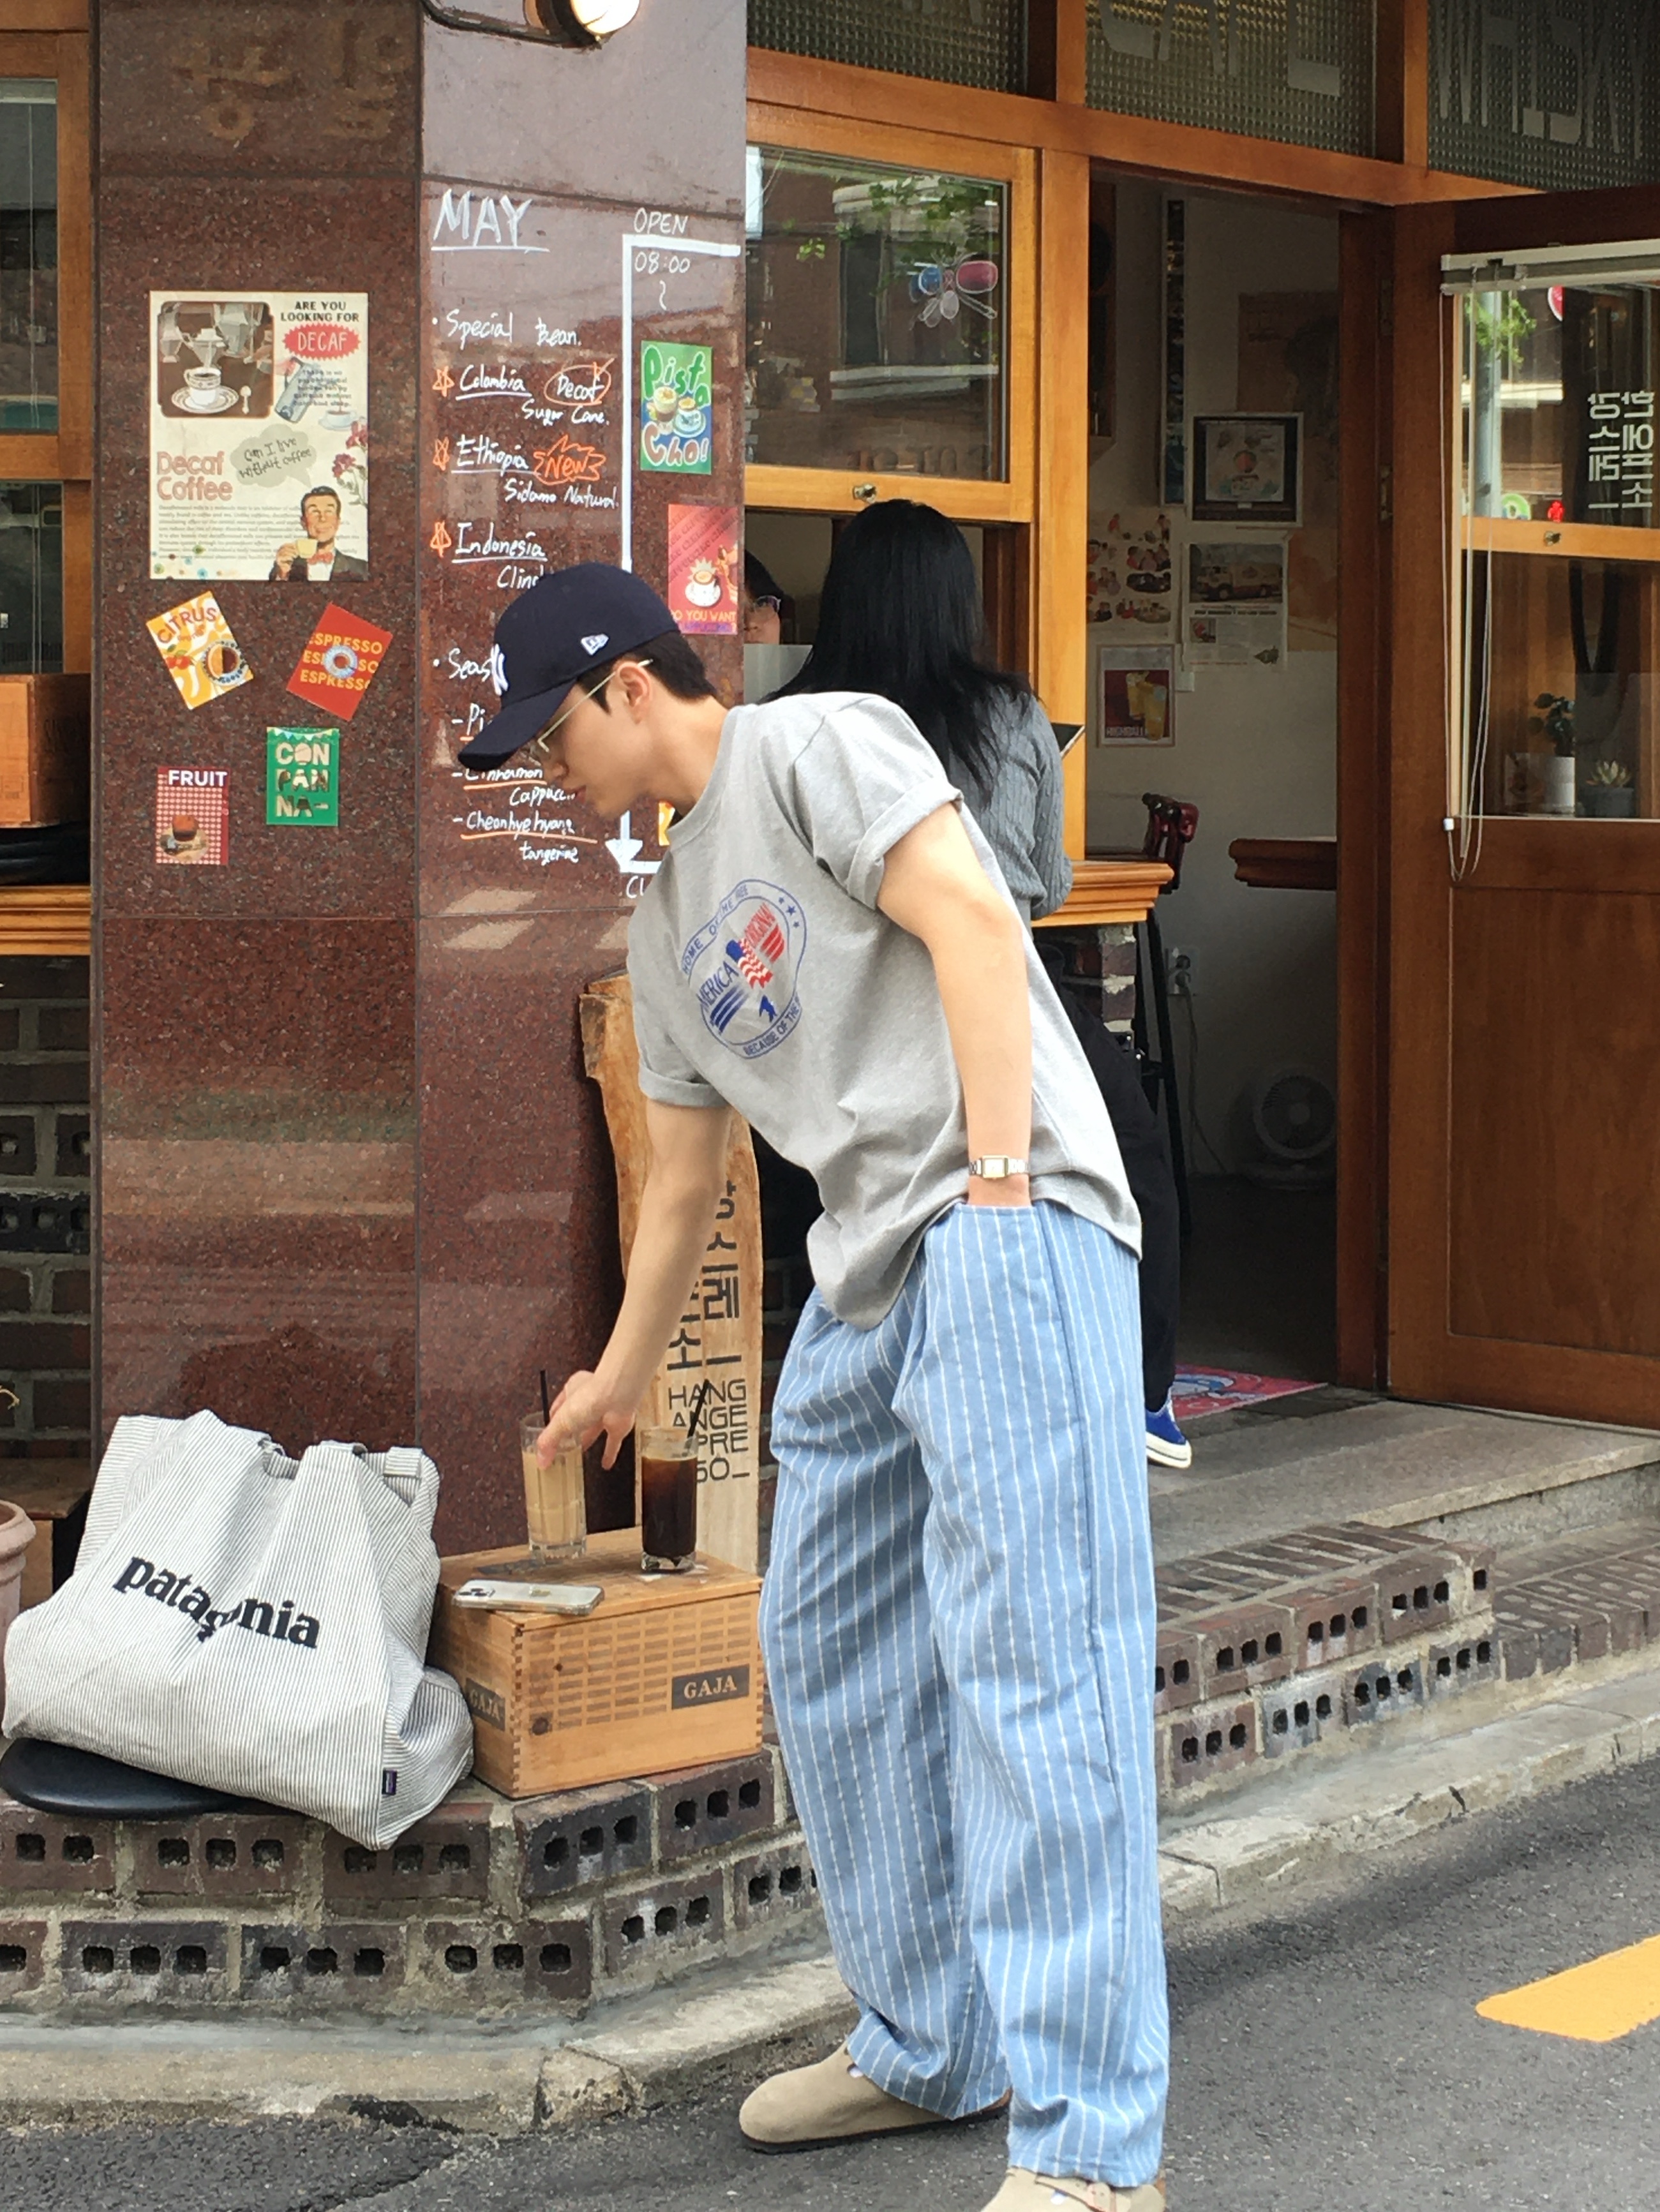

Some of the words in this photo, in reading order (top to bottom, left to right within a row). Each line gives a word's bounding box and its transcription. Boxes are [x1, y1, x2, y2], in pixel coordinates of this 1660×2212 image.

[433, 189, 532, 247] MAY
[634, 208, 688, 234] OPEN
[634, 251, 691, 274] 08:00
[280, 312, 333, 322] LOOKING
[336, 313, 359, 322] FOR
[294, 301, 317, 310] ARE
[321, 301, 347, 310] YOU
[297, 332, 348, 352] DECAF
[447, 310, 513, 350] Special
[157, 451, 225, 475] Decaf
[157, 476, 233, 500] Coffee
[456, 522, 545, 557] Indonesia
[157, 607, 218, 643] CITRUS
[686, 610, 707, 621] YOU
[709, 611, 738, 622] WANT
[276, 742, 329, 766] CON
[168, 770, 228, 787] FRUIT
[276, 769, 330, 792] PAN
[668, 1379, 747, 1410] HANG
[683, 1675, 738, 1700] GAJA
[468, 1688, 502, 1721] GAJA
